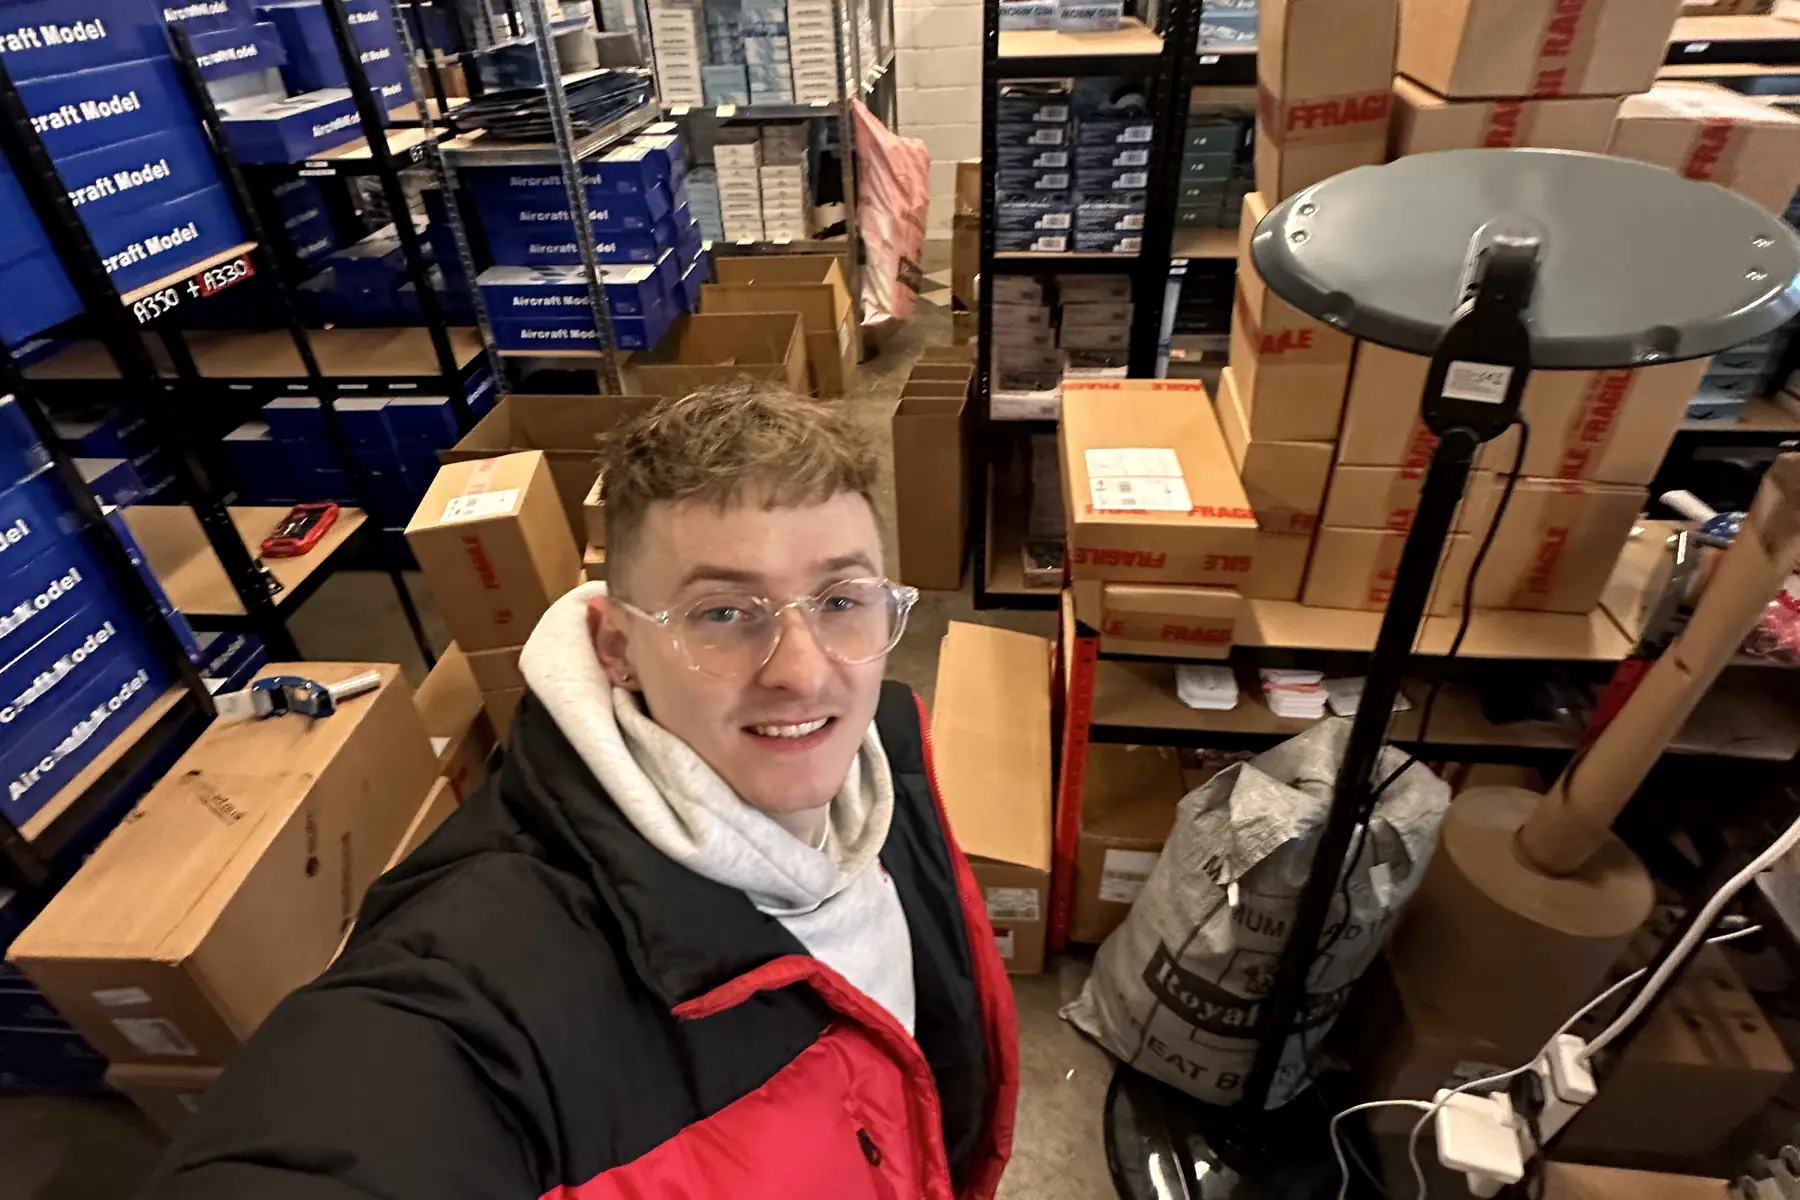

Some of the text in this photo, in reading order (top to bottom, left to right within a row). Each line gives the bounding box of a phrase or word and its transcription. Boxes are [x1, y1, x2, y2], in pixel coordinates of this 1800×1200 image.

[39, 18, 107, 46] Model
[79, 90, 140, 121] Model
[113, 158, 170, 191] Model
[144, 221, 199, 255] Model
[133, 288, 180, 324] A350
[203, 259, 248, 292] A330
[512, 295, 561, 306] Aircraft
[520, 329, 570, 340] Aircraft
